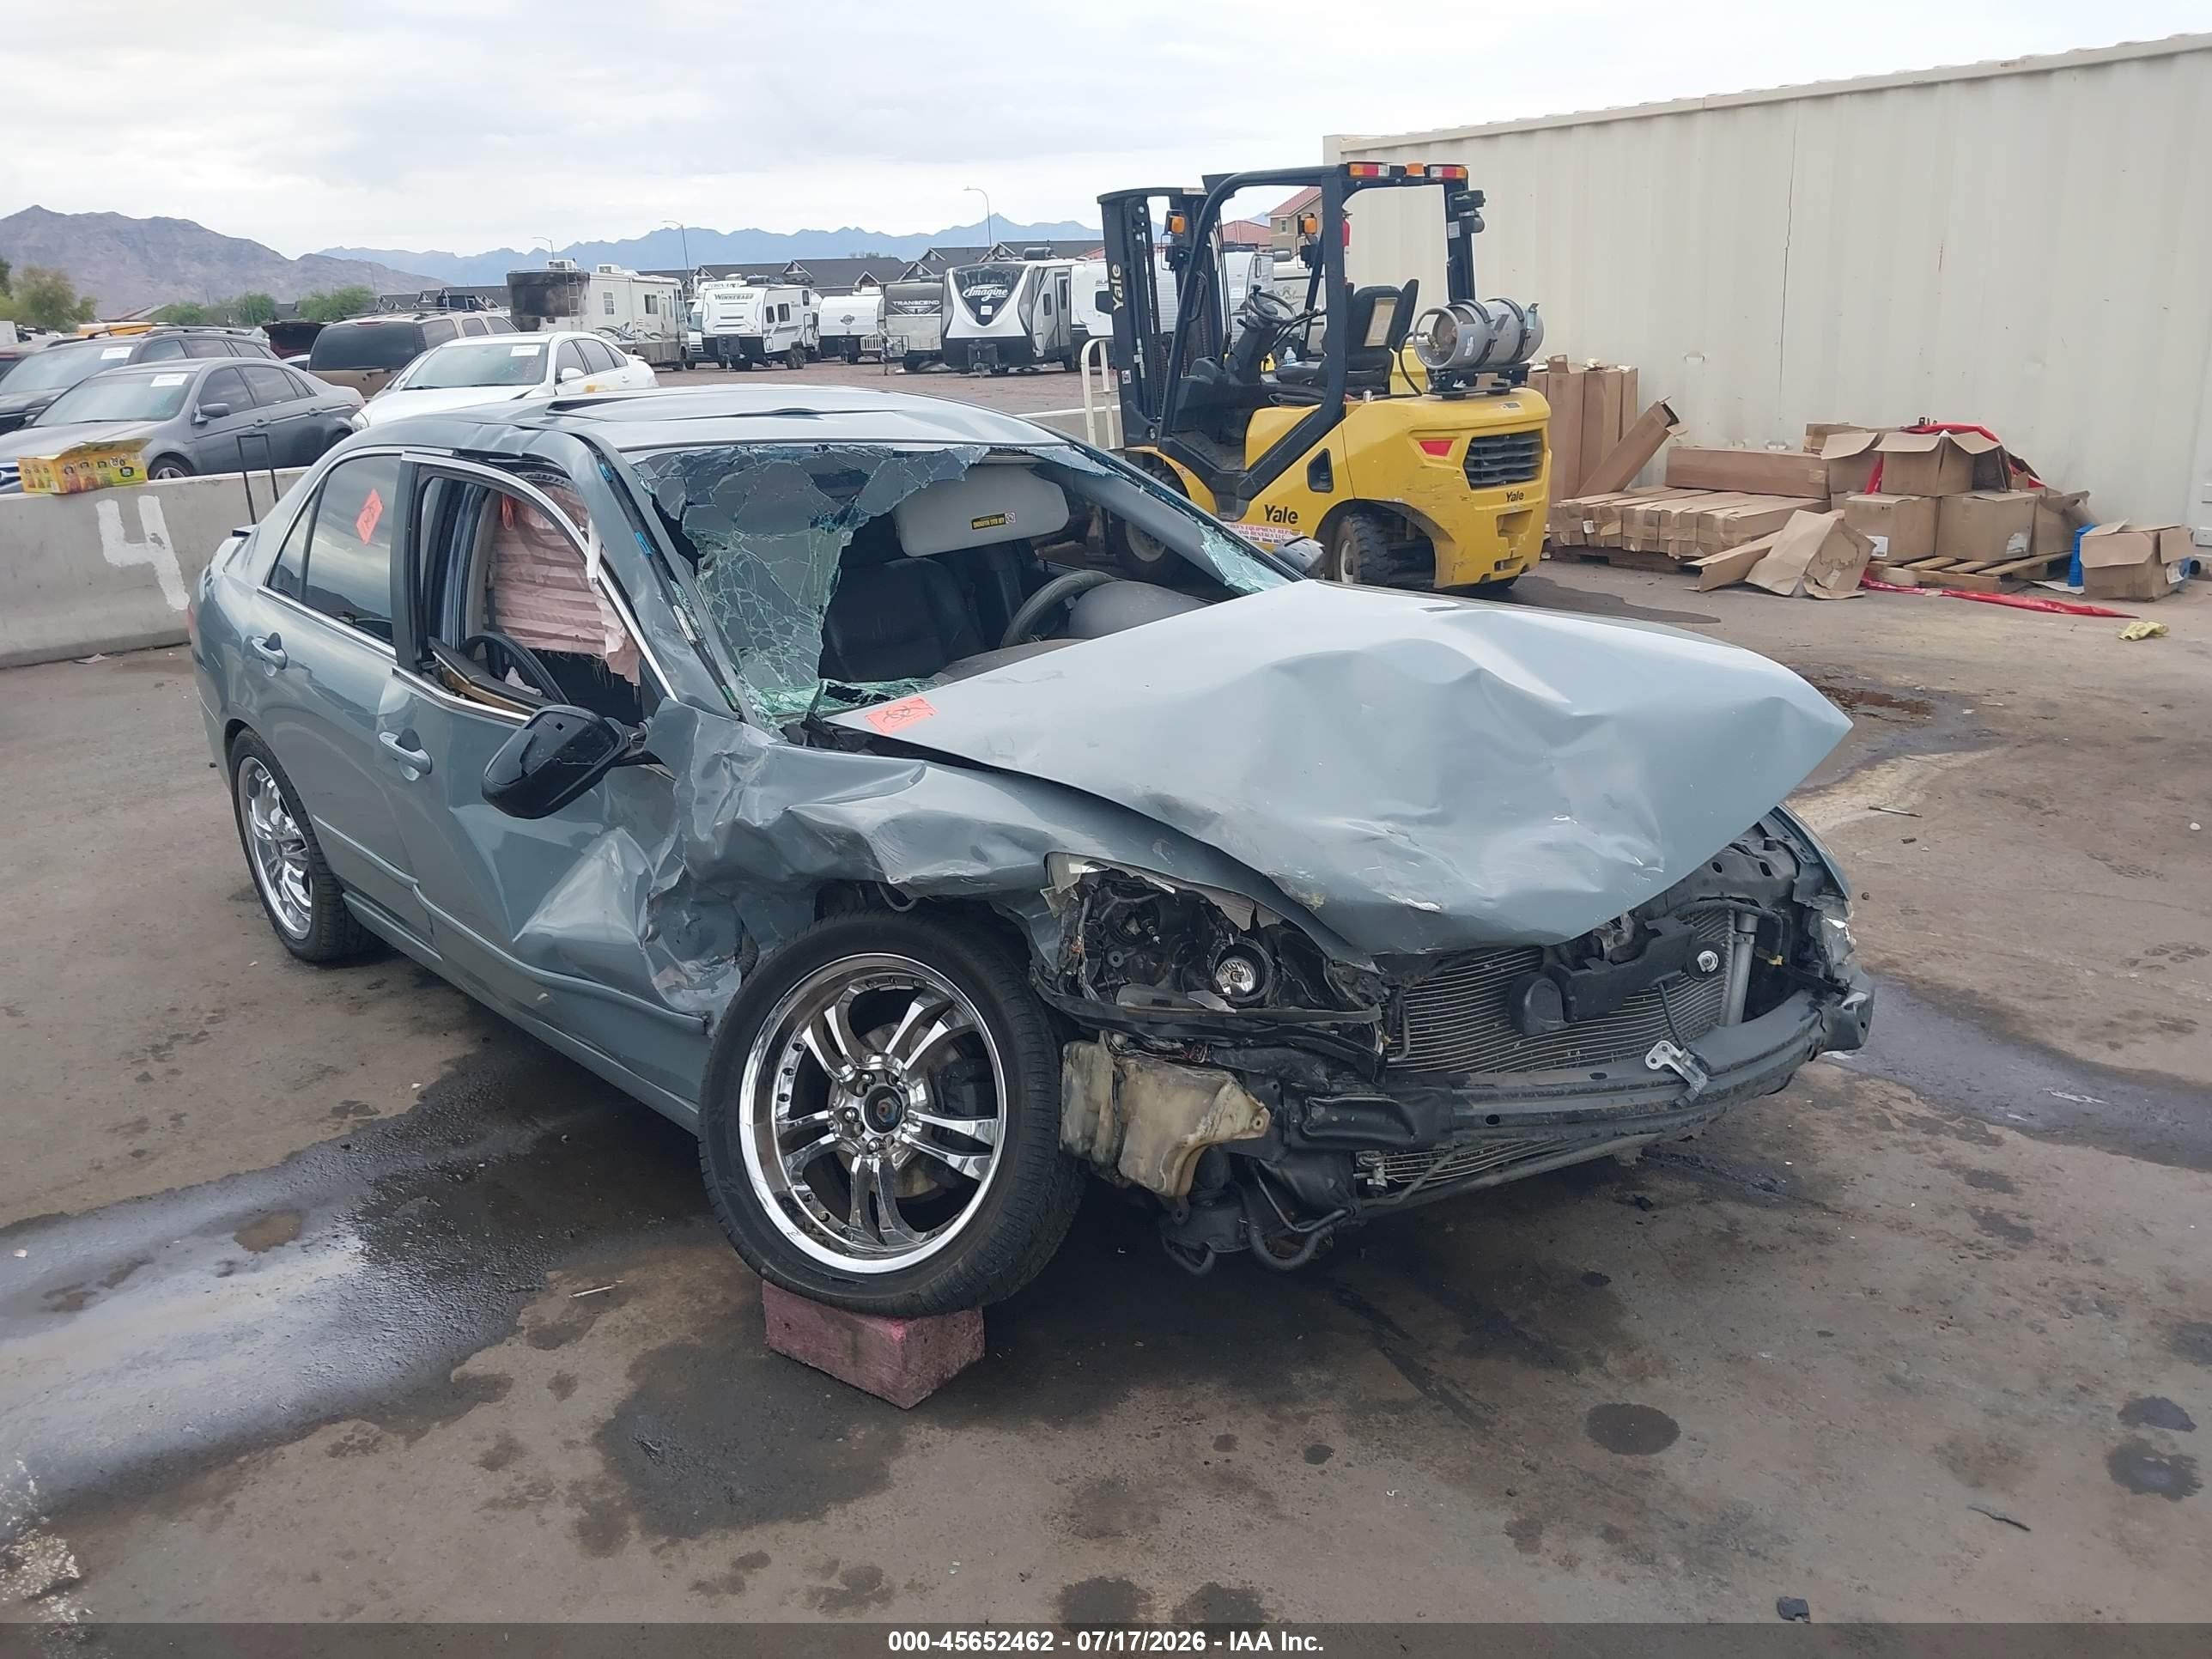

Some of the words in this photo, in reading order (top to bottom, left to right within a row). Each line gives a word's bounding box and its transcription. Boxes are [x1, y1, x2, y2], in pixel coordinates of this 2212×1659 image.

[962, 283, 1010, 302] Imagine
[1111, 263, 1124, 311] Yale
[1506, 490, 1524, 502] Yale
[1264, 504, 1298, 525] Yale
[95, 495, 191, 611] 4
